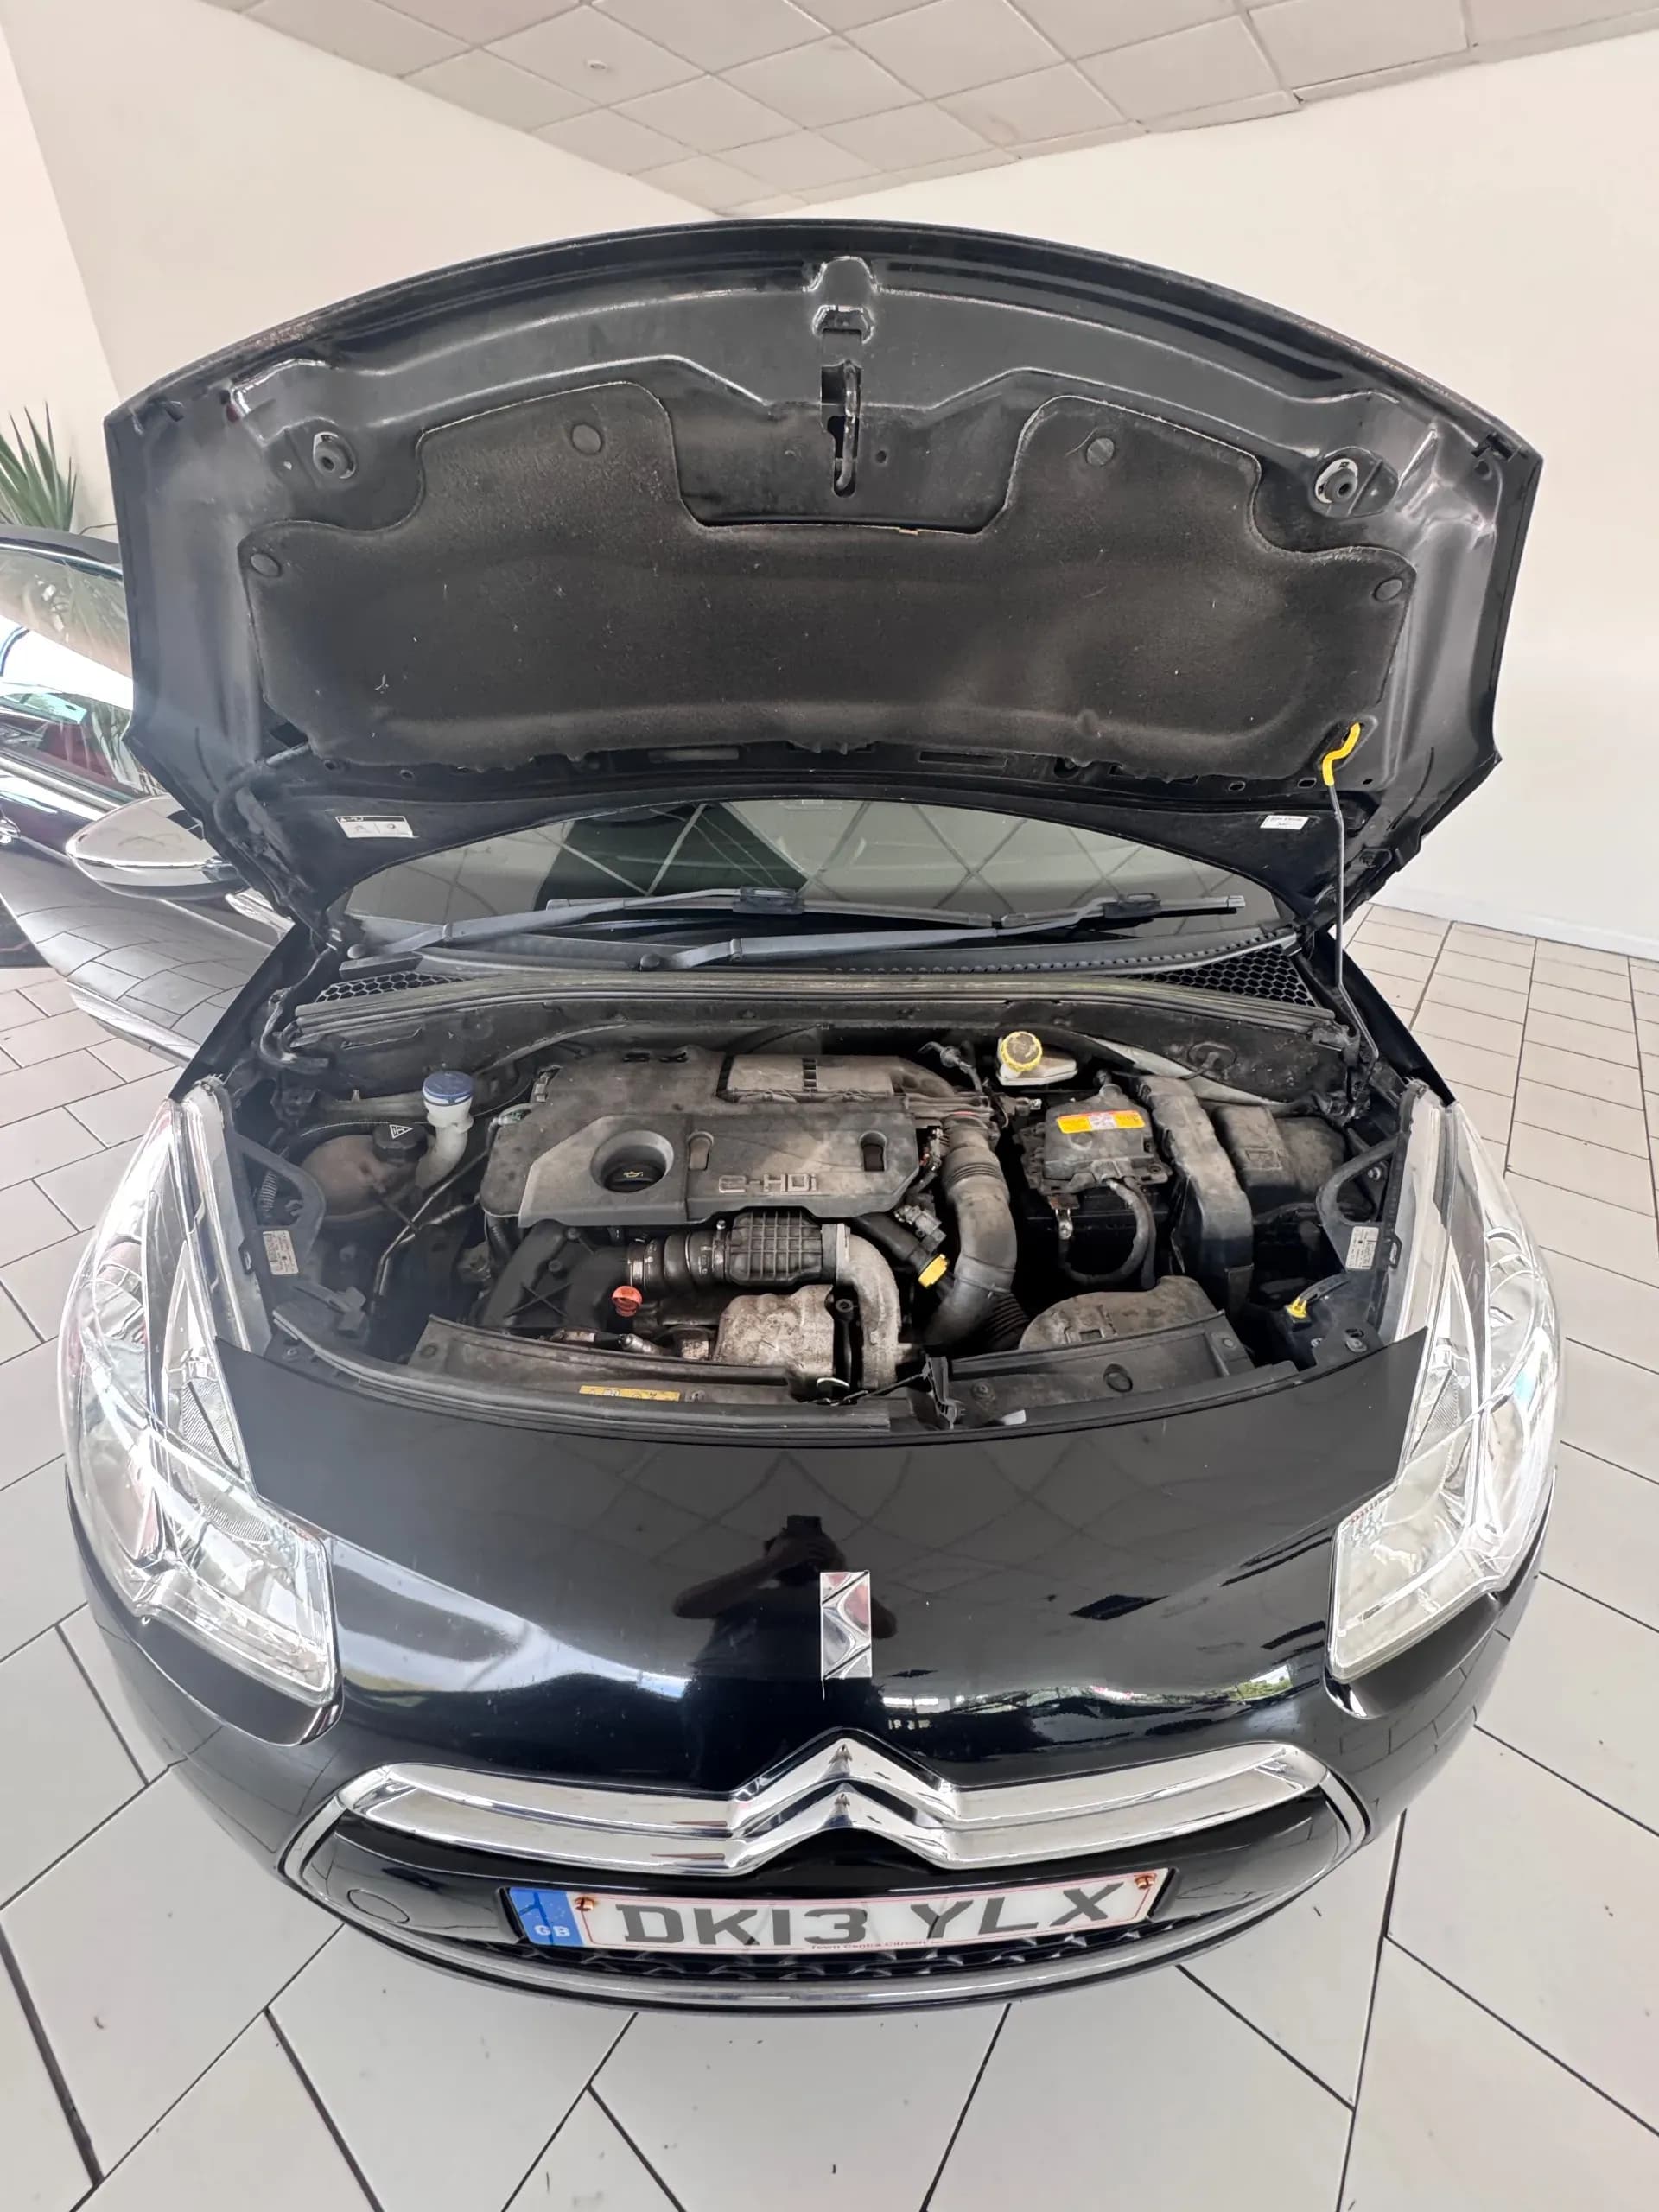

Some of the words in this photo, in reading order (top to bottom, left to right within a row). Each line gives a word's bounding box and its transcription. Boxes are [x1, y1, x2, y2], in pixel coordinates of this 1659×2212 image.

[534, 1924, 571, 1937] GB
[615, 1904, 868, 1946] DK13
[910, 1881, 1125, 1940] YLX
